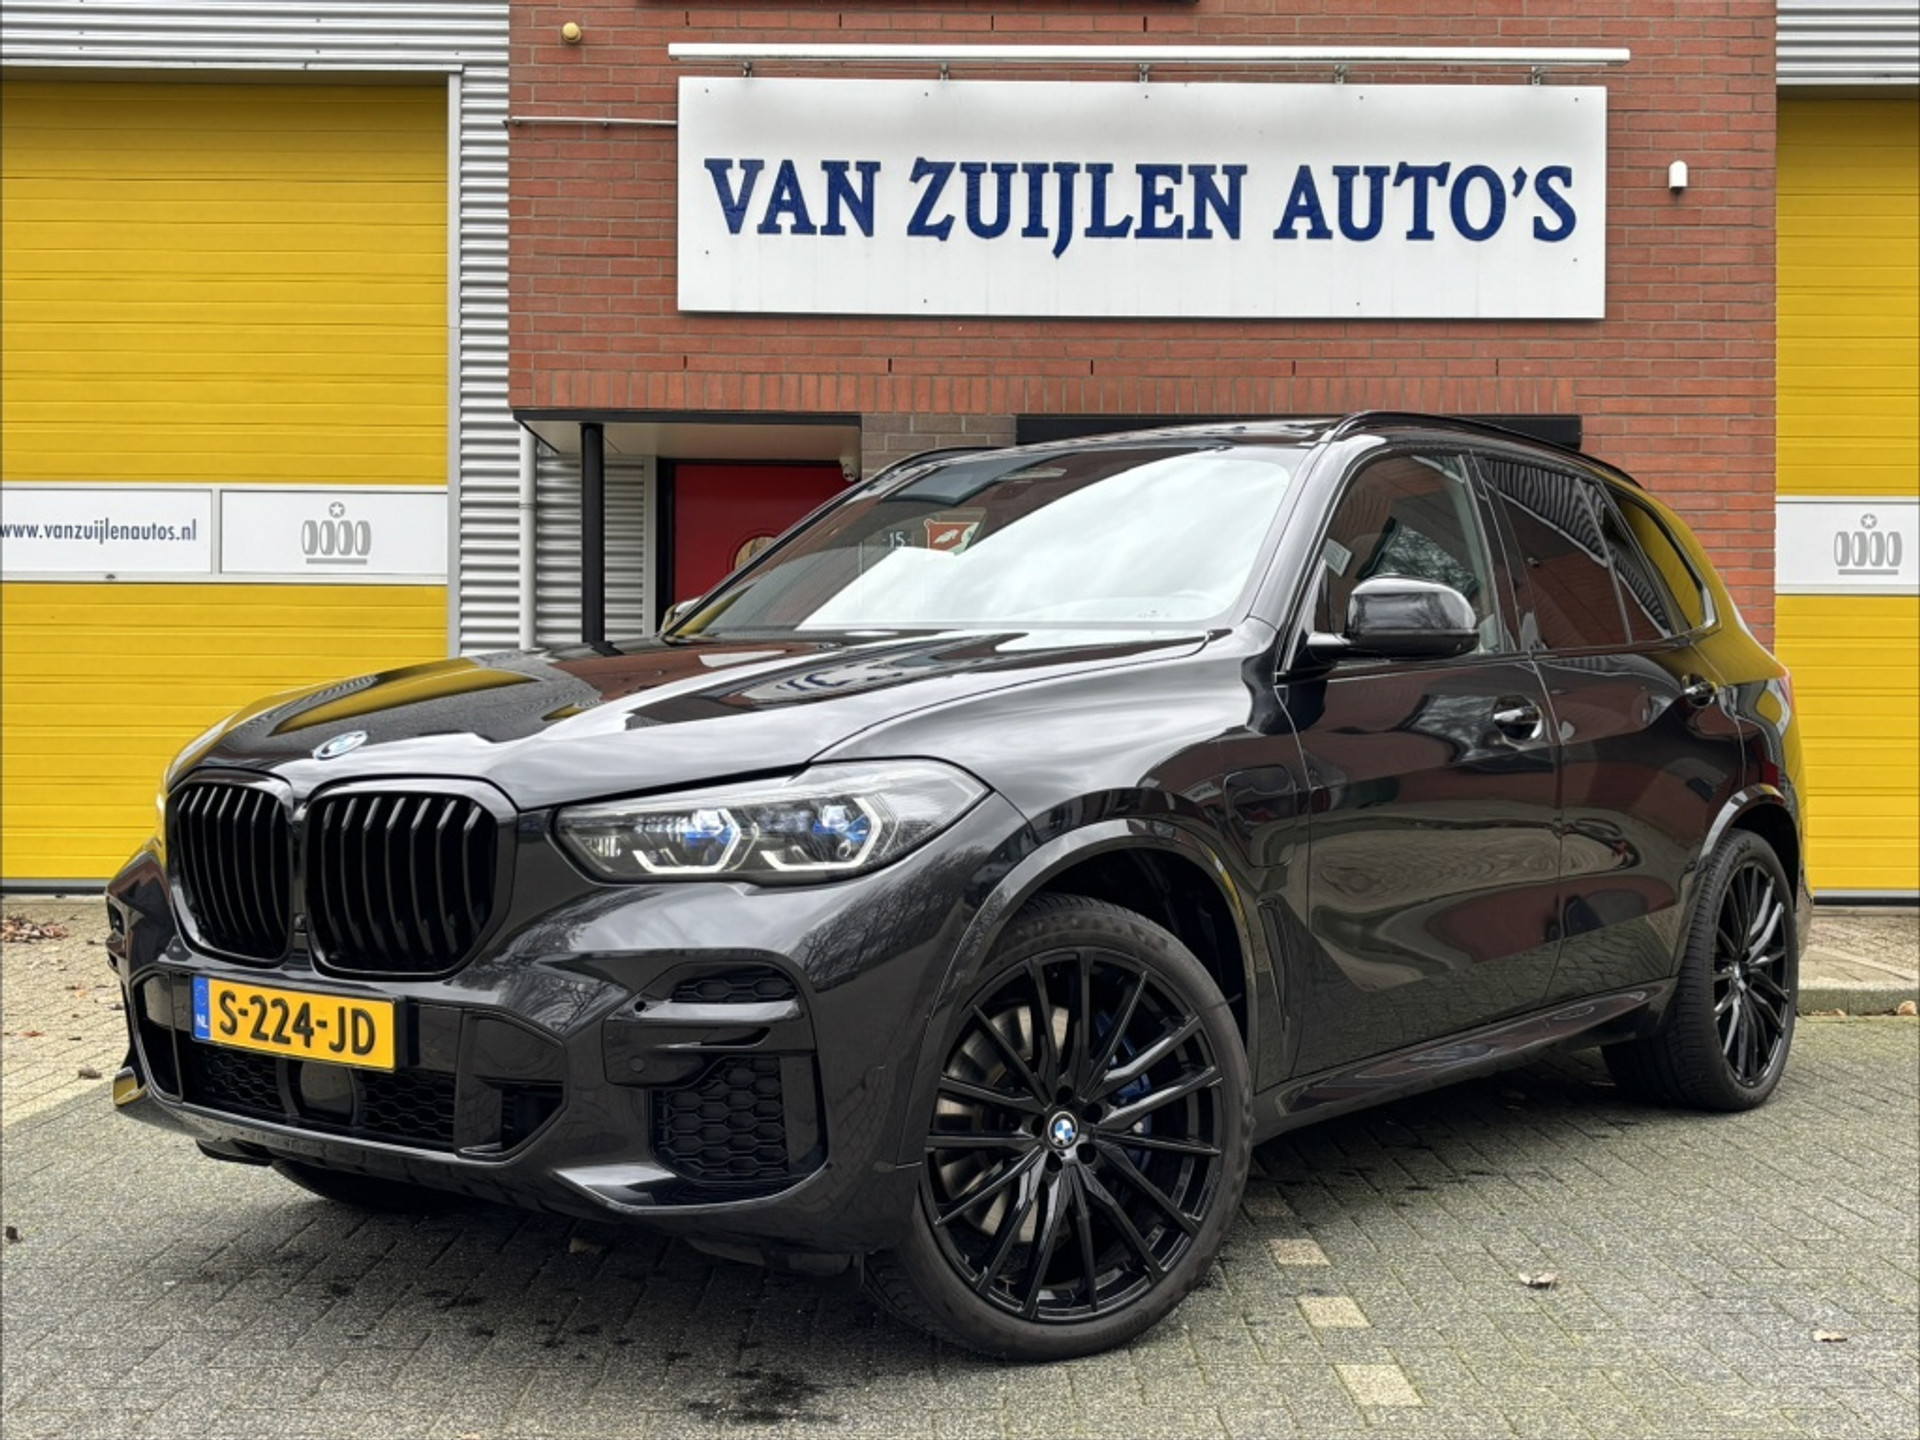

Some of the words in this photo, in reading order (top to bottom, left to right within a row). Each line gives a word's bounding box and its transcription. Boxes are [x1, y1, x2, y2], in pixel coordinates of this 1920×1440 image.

[704, 158, 880, 238] VAN
[906, 158, 1248, 259] ZUIJLEN
[1272, 161, 1577, 243] AUTO'S
[0, 517, 197, 545] www.vanzuijlenautos.nl
[219, 990, 376, 1056] S-224-JD
